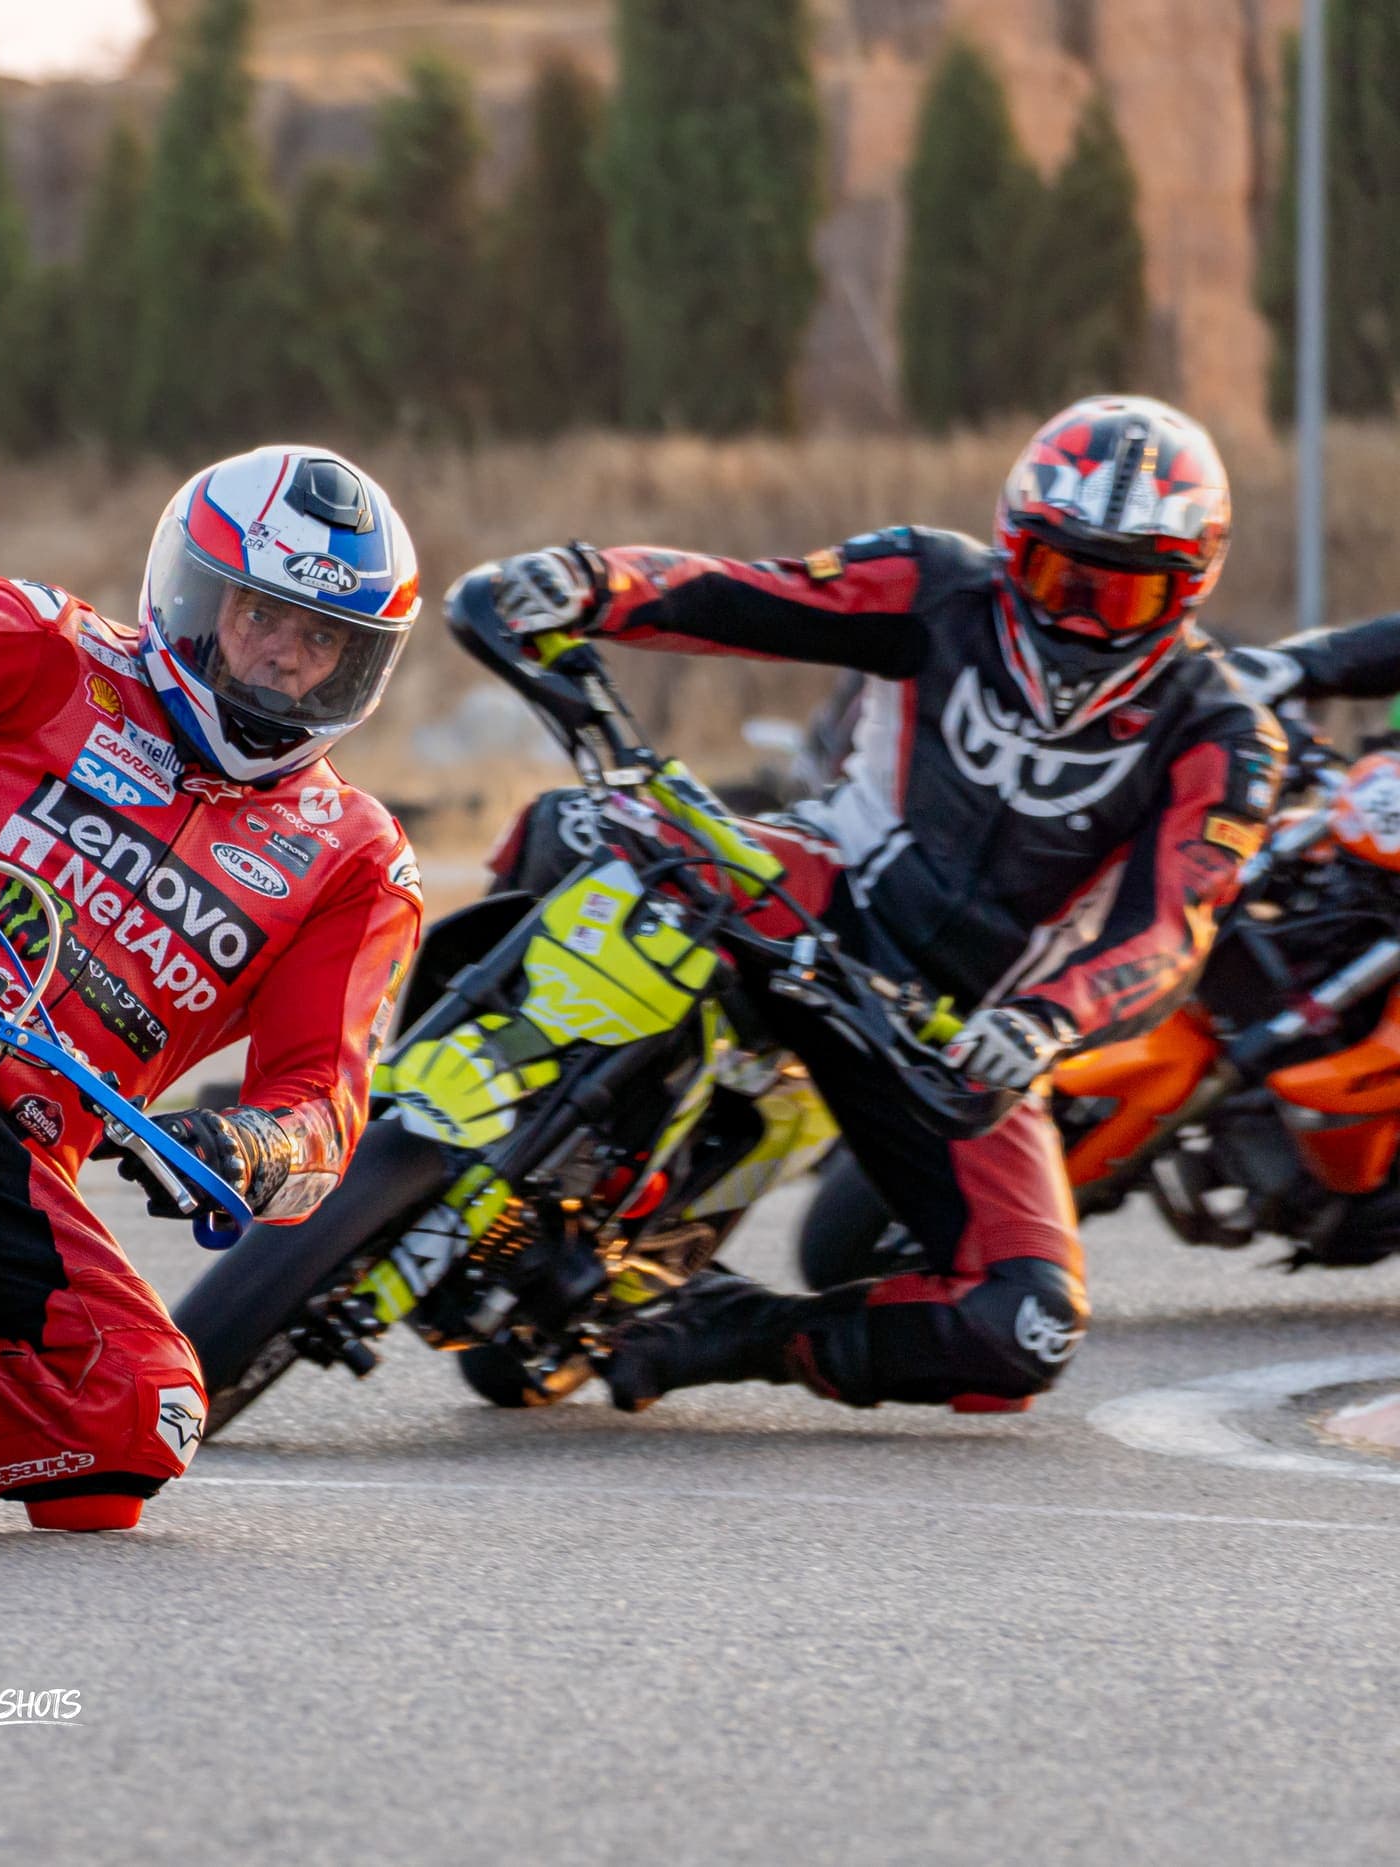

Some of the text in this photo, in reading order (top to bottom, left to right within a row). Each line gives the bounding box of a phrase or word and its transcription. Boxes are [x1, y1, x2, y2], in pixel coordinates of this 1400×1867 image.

[289, 556, 352, 589] Airoh
[71, 757, 141, 804] SAP
[94, 734, 170, 795] CARRERA
[271, 803, 340, 848] motorola
[273, 833, 309, 862] Lenovo
[31, 779, 248, 968] Lenovo
[218, 847, 280, 895] SUOMY
[53, 854, 217, 1012] NetApp
[66, 935, 168, 1049] MONSTER
[69, 967, 150, 1054] ENERGY
[24, 1099, 58, 1139] Estrella
